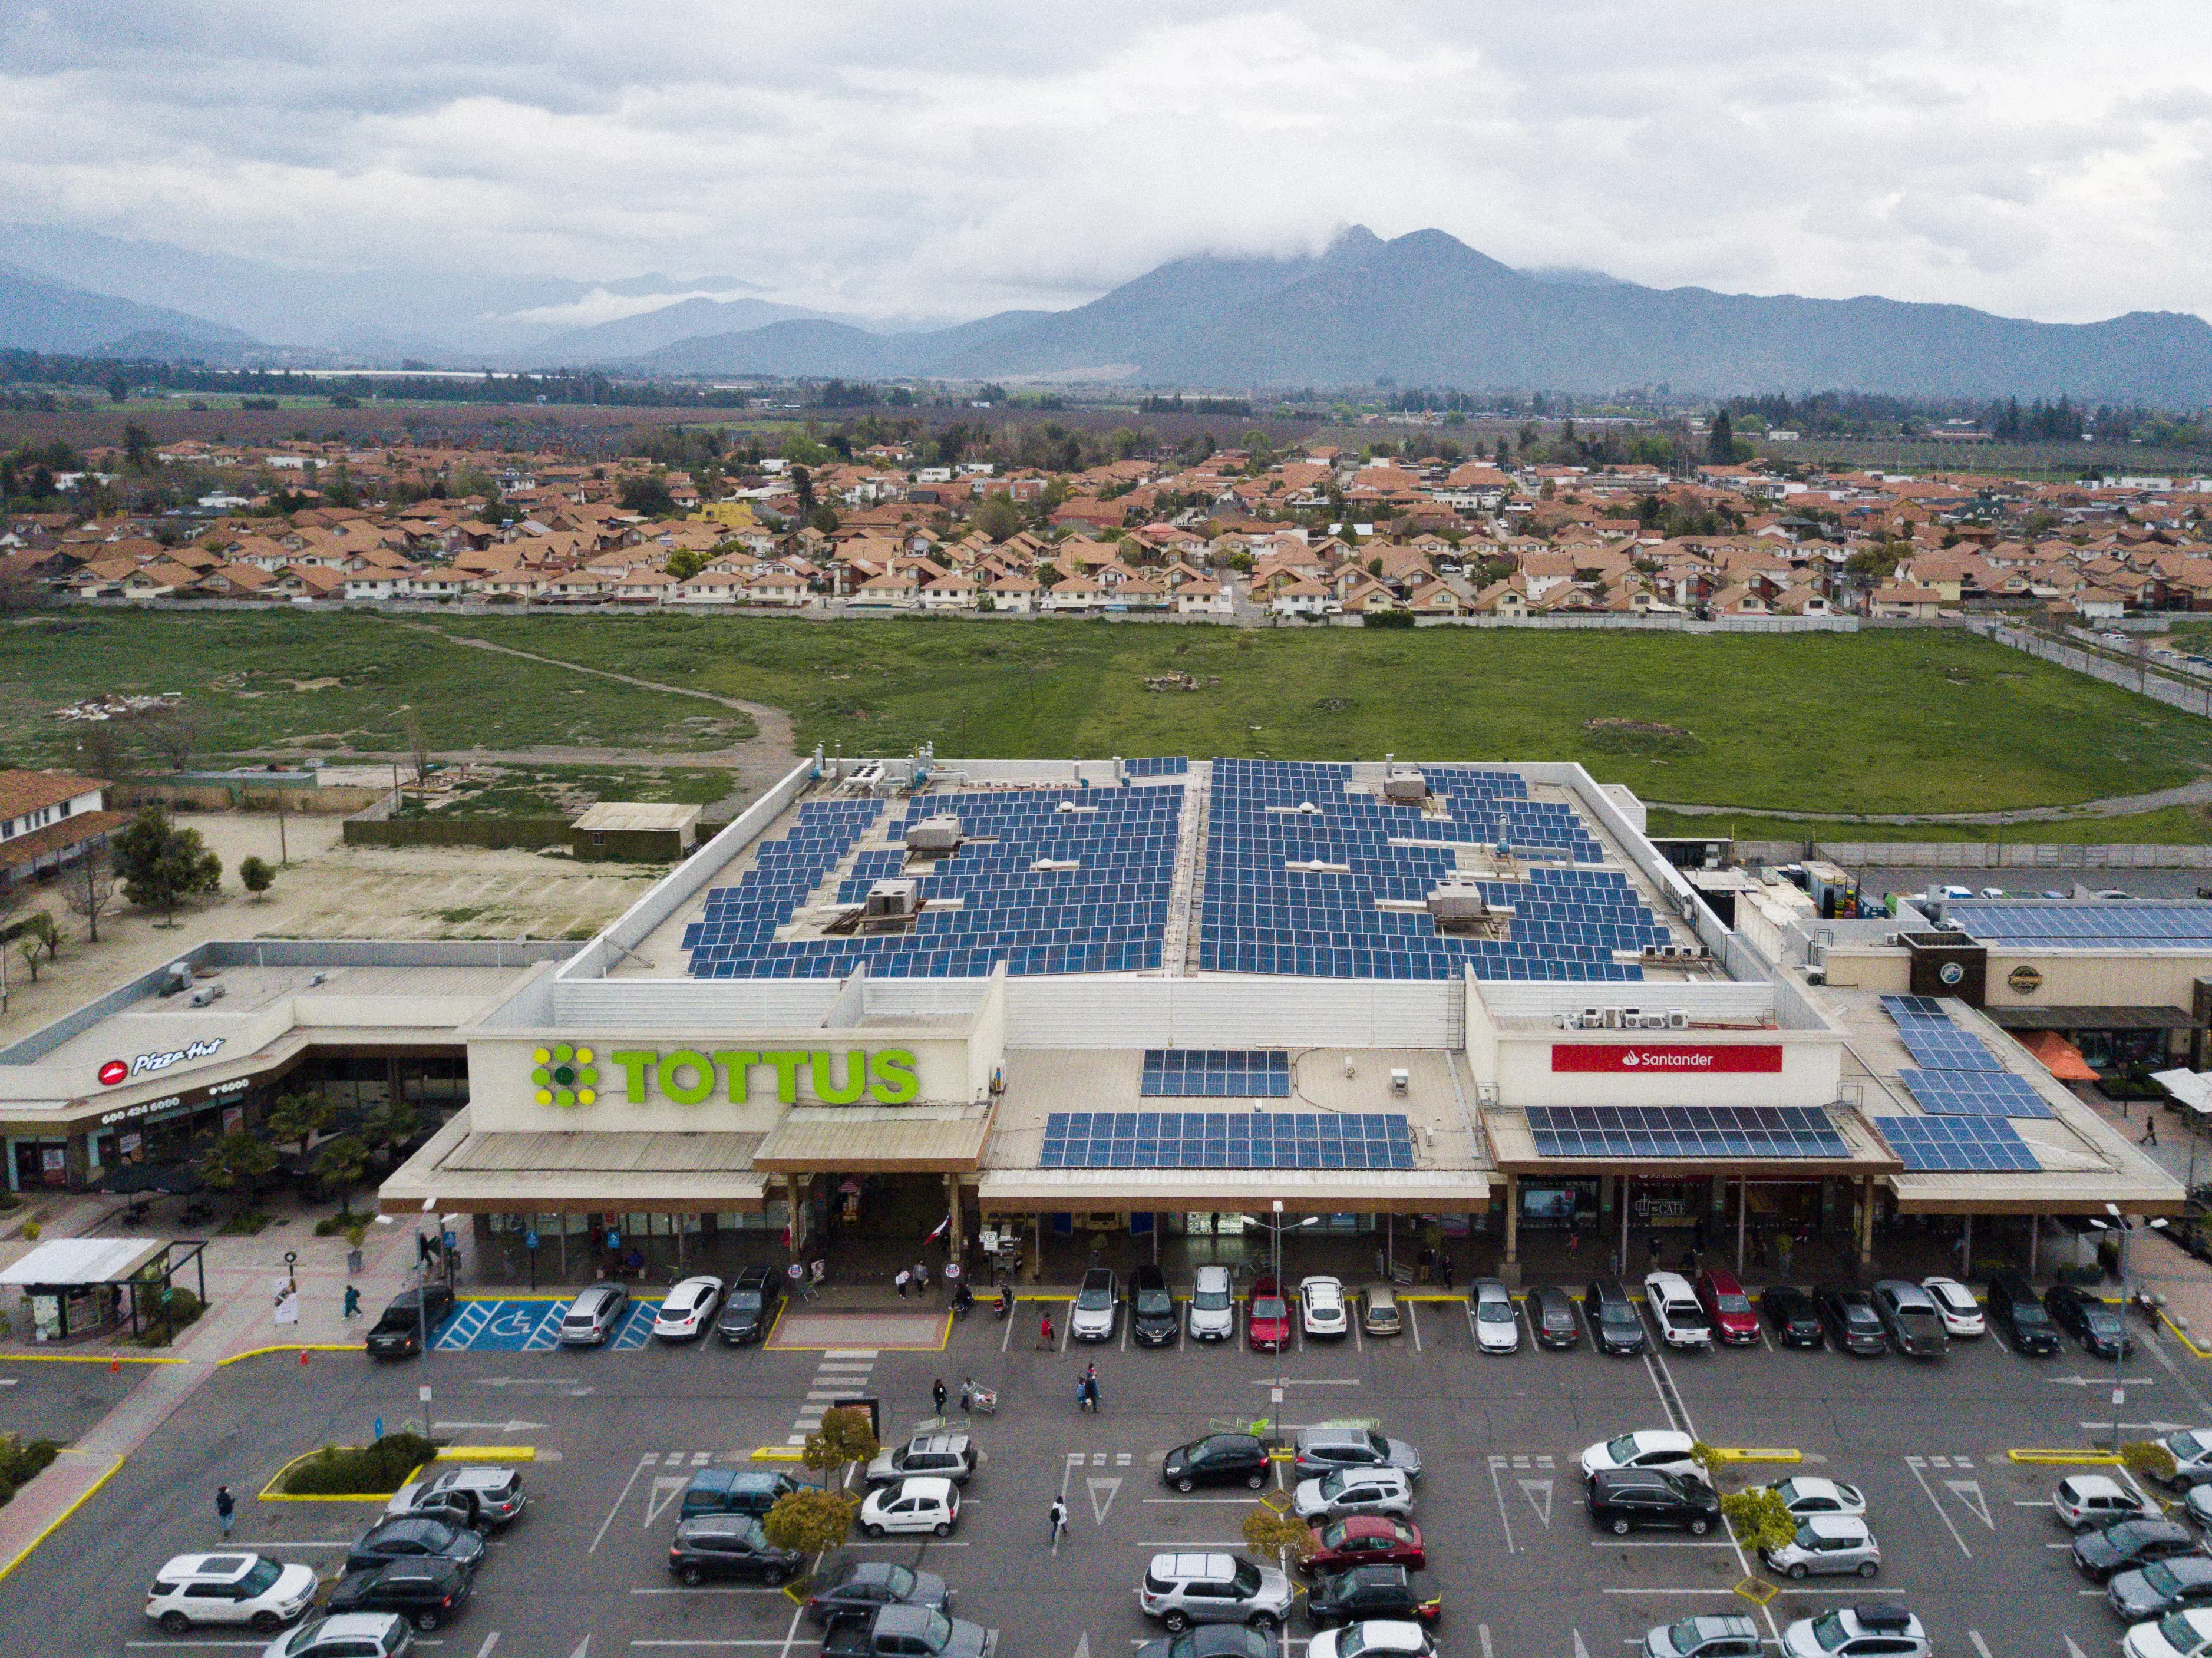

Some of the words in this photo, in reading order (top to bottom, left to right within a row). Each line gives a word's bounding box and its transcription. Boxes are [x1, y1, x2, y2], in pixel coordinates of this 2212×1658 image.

[131, 1051, 186, 1077] Pizza
[186, 1038, 226, 1060] Hut
[1642, 1053, 1714, 1065] Santander
[611, 1049, 919, 1105] TOTTUS
[101, 1111, 125, 1124] 600
[150, 1097, 180, 1112] 6000
